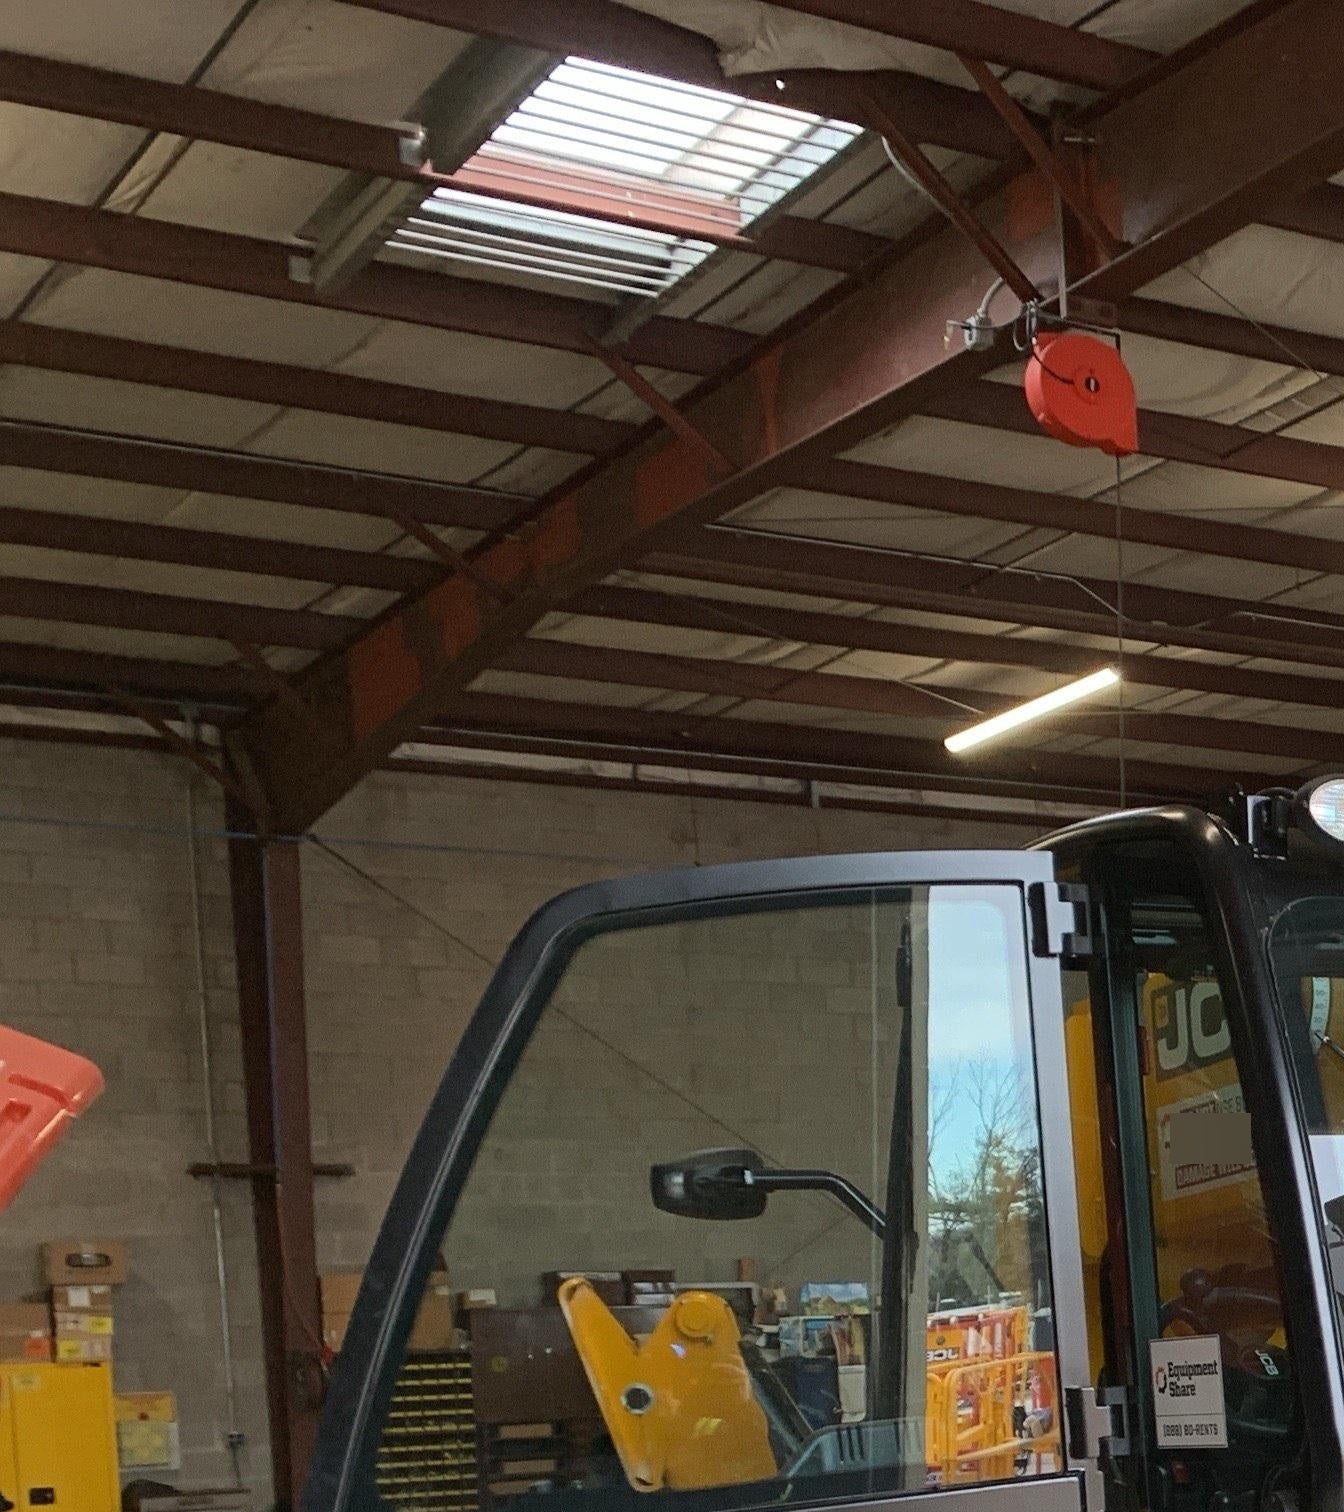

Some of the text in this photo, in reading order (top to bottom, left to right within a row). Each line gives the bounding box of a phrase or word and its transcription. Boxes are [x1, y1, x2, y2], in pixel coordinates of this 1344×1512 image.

[1157, 981, 1231, 1070] JC
[1167, 1360, 1219, 1381] Equipment
[1254, 1349, 1279, 1377] JCB
[1168, 1382, 1197, 1398] Share
